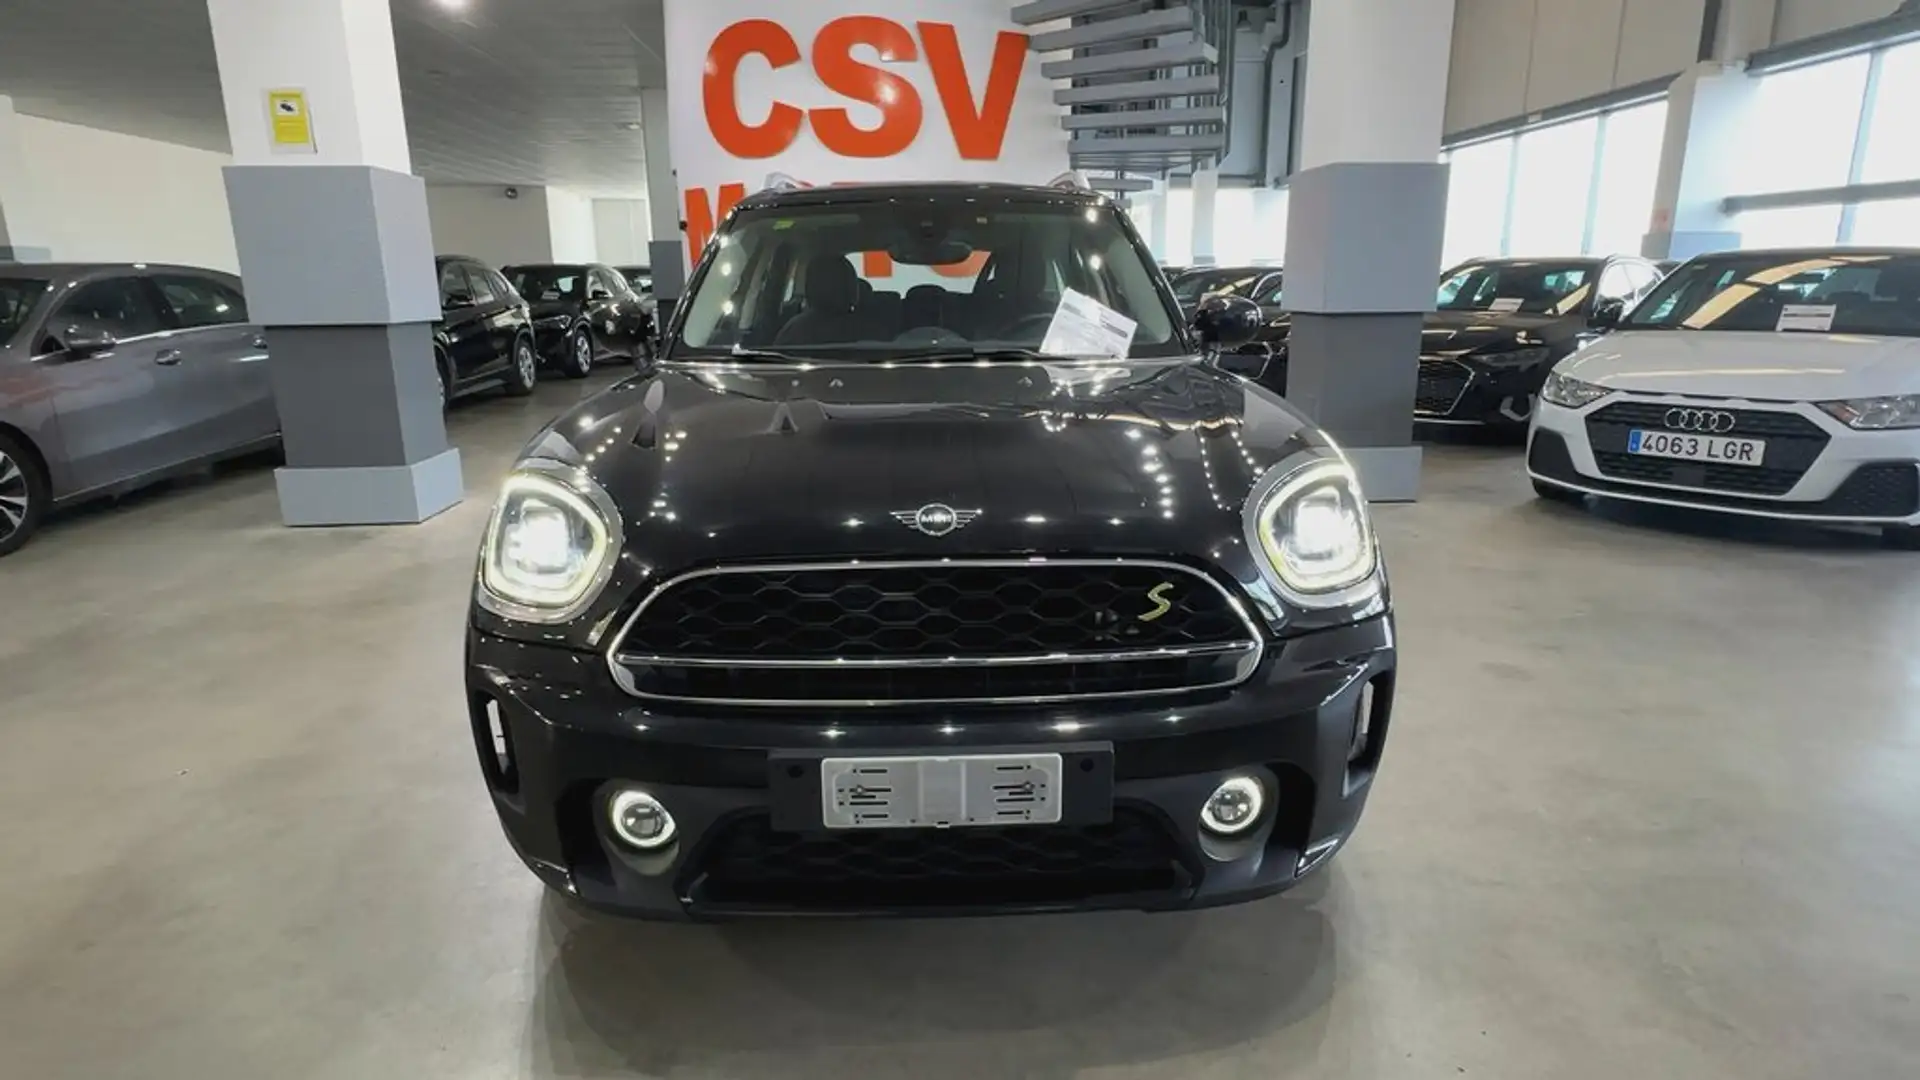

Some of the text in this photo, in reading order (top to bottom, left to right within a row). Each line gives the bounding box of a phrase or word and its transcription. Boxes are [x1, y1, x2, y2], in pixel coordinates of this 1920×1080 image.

[702, 14, 1030, 161] CSV
[1642, 434, 1754, 461] 4063 LGR
[1137, 581, 1174, 622] S
